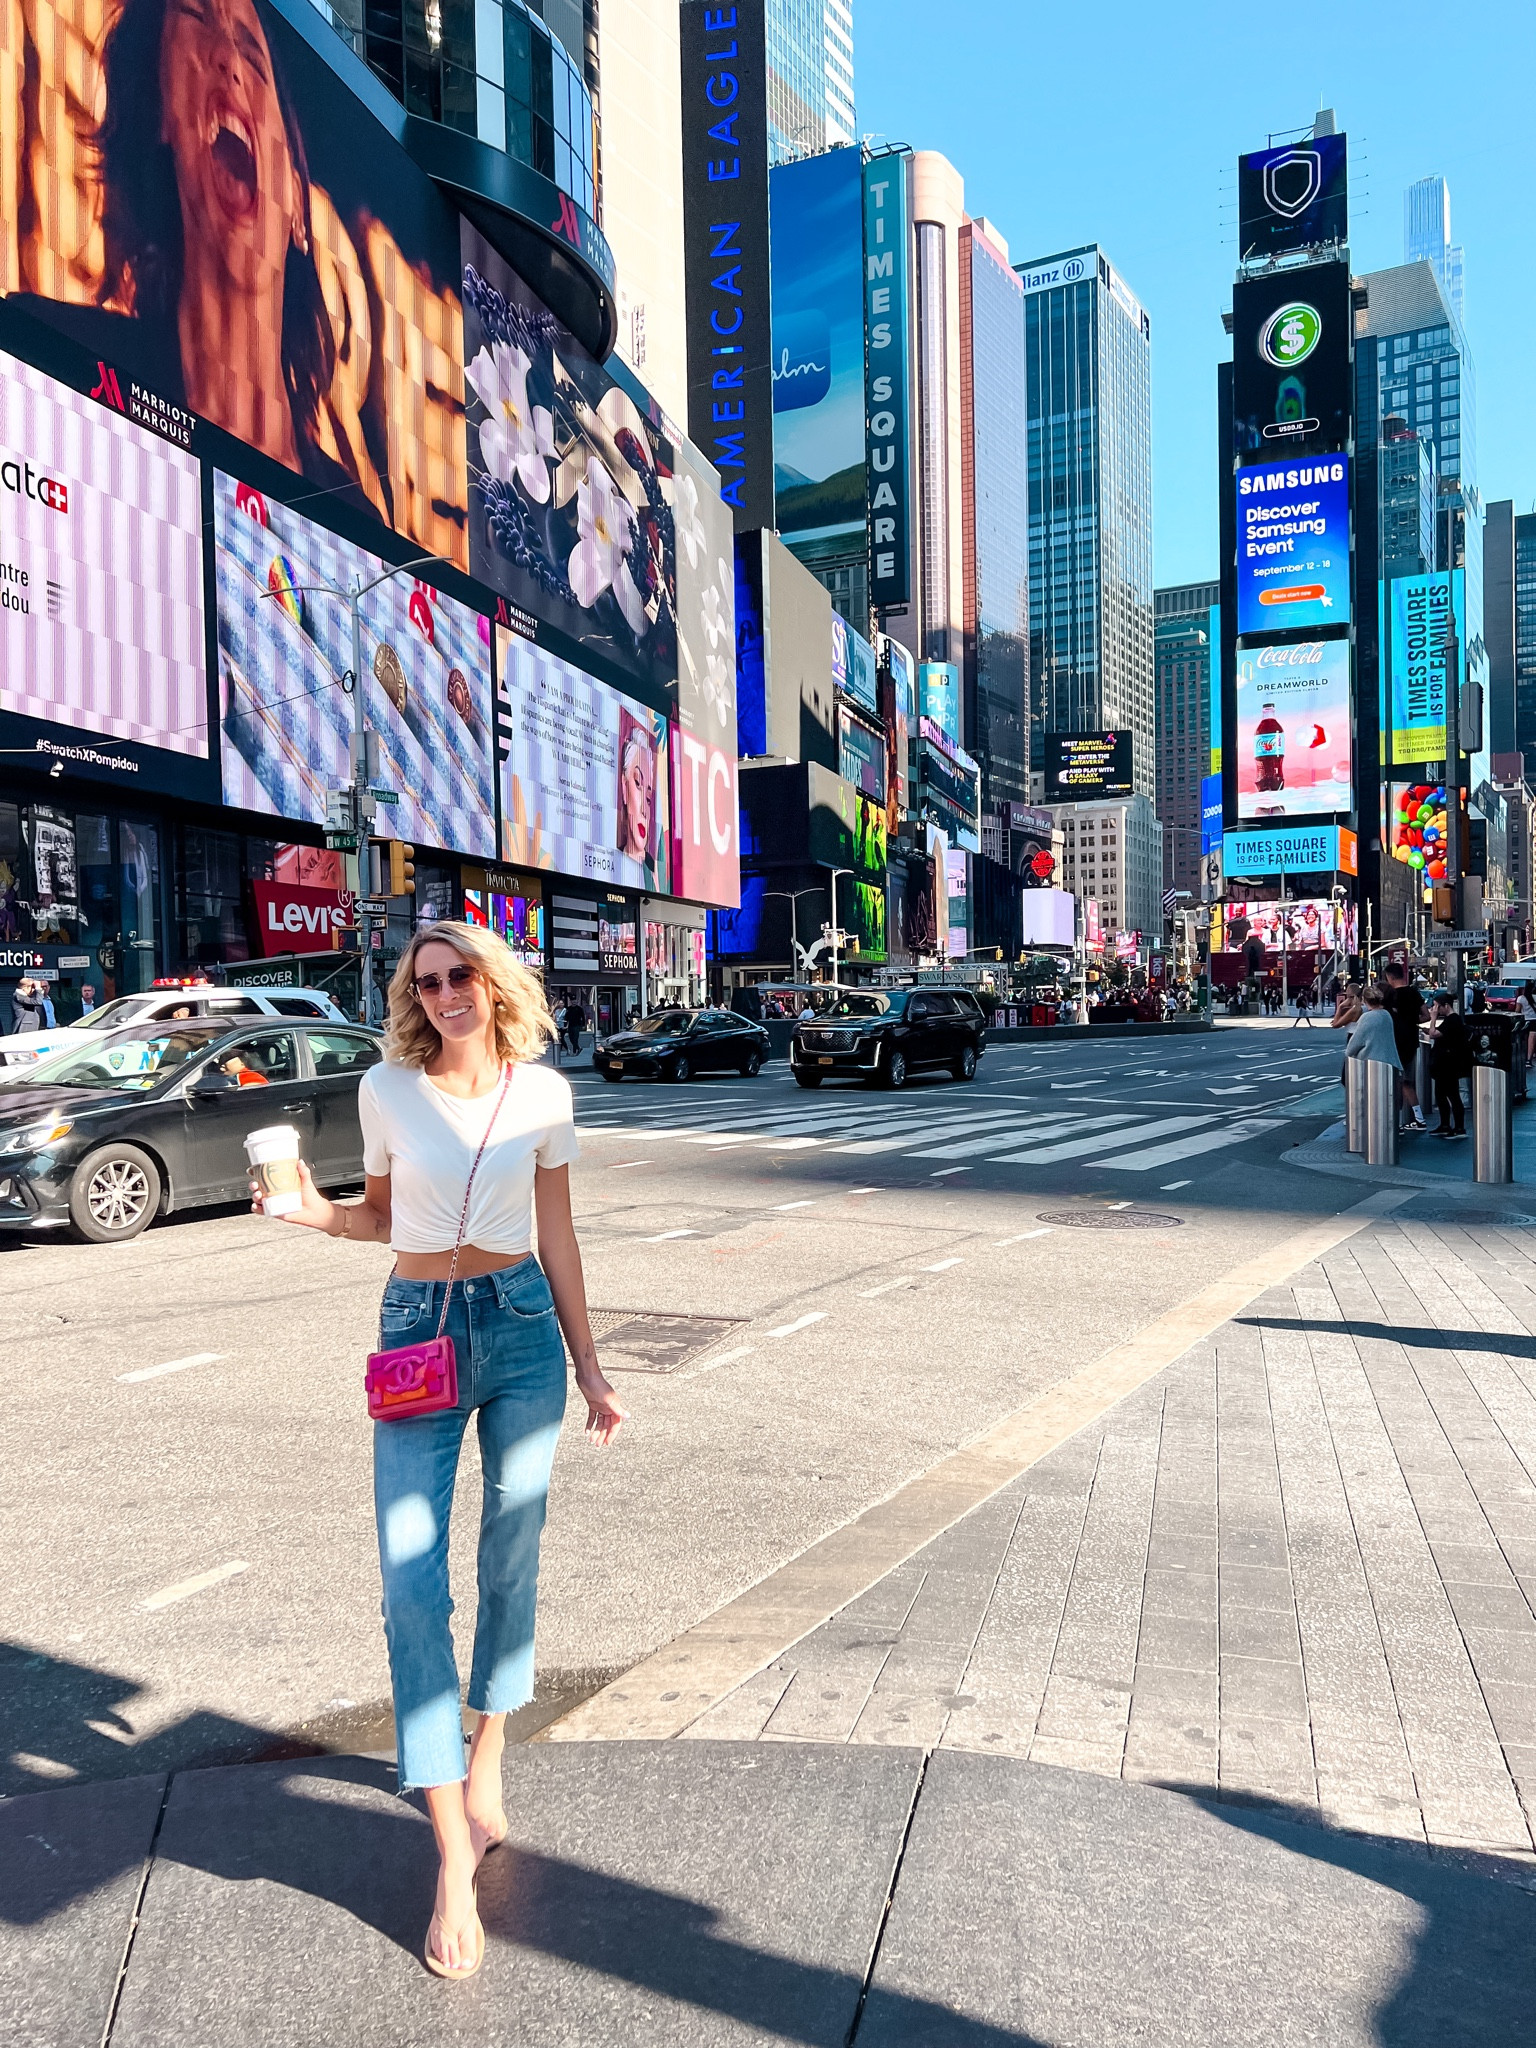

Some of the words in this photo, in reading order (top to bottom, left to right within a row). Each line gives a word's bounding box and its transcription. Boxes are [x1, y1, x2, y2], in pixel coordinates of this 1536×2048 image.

[705, 5, 739, 184] EAGLE
[870, 181, 893, 350] TIMES
[1022, 269, 1059, 290] lianz
[709, 221, 746, 508] AMERICAN
[772, 347, 826, 380] alm
[131, 382, 197, 430] MARRIOTT
[132, 401, 190, 444] MARQUIS
[871, 375, 895, 579] SQUARE
[1239, 463, 1344, 495] SAMSUNG
[1246, 501, 1321, 523] Discover
[1246, 518, 1326, 540] Samsung
[1247, 537, 1295, 558] Event
[1253, 563, 1305, 578] September
[1306, 561, 1315, 570] 12
[1322, 559, 1331, 568] 18
[510, 605, 538, 629] MARRIOTT
[510, 617, 536, 639] MARQUIS
[1407, 586, 1427, 661] SQUARE
[1256, 641, 1328, 669] Coca-Cola
[1256, 678, 1329, 692] DREAMWORLD
[1407, 665, 1427, 721] TIMES
[1430, 673, 1444, 698] FOR
[1430, 703, 1444, 717] IS
[36, 739, 139, 772] #SwatchXPompidou
[343, 836, 351, 846] 45
[1235, 840, 1272, 854] TIMES
[1275, 836, 1327, 852] SQUARE
[584, 854, 615, 873] SEPHORA
[1236, 856, 1245, 864] IS
[1248, 854, 1265, 863] FOR
[1268, 850, 1326, 865] FAMILIES
[357, 903, 368, 911] ONE
[1430, 931, 1460, 939] PEDESTRIAN
[0, 949, 34, 966] atch
[604, 954, 638, 969] SEPHORA
[1153, 957, 1164, 977] tkts
[233, 970, 293, 987] DISCOVER
[918, 972, 967, 983] SWAROVSKI
